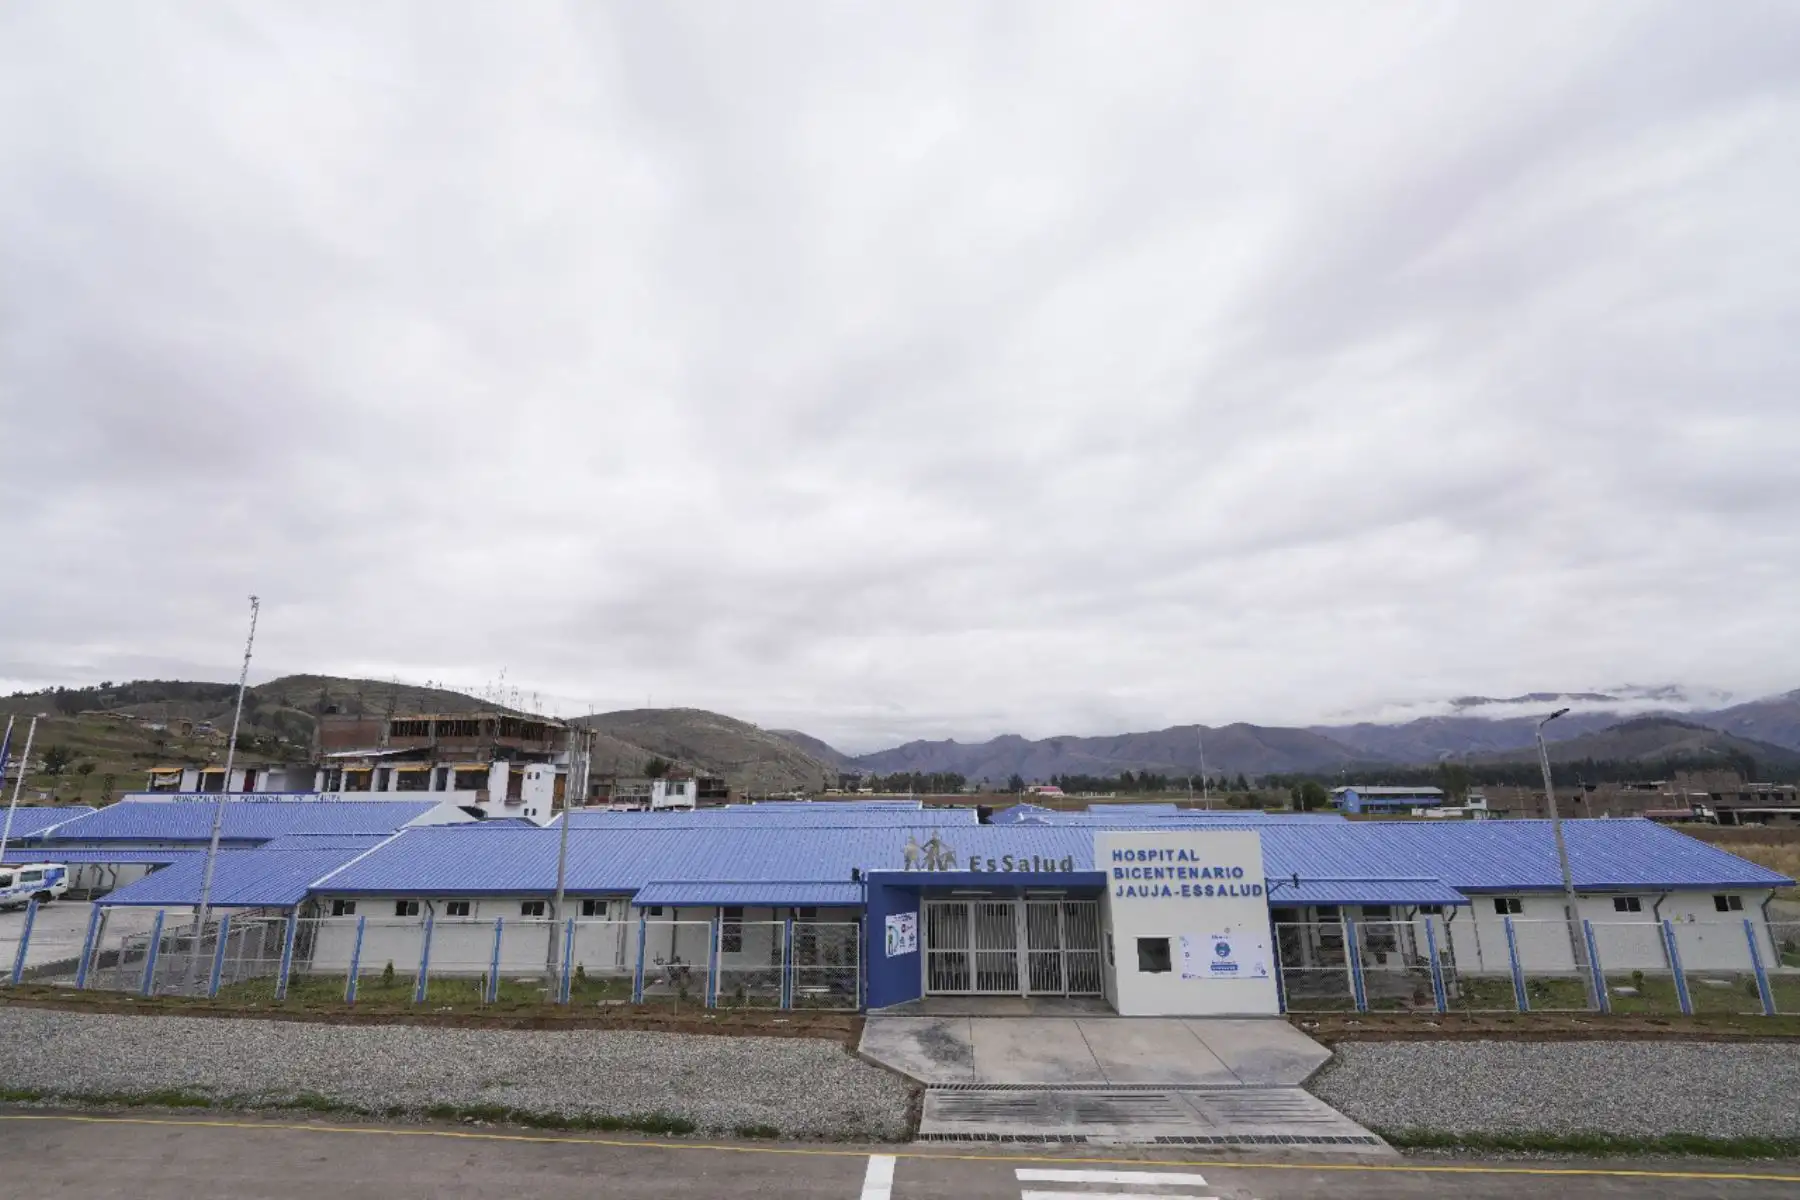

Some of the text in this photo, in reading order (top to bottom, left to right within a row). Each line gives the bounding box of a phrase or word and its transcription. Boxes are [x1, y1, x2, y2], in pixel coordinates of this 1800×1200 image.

[1112, 849, 1200, 862] HOSPITAL
[969, 854, 1074, 873] EsSalud
[1113, 866, 1244, 880] BICENTENARIO
